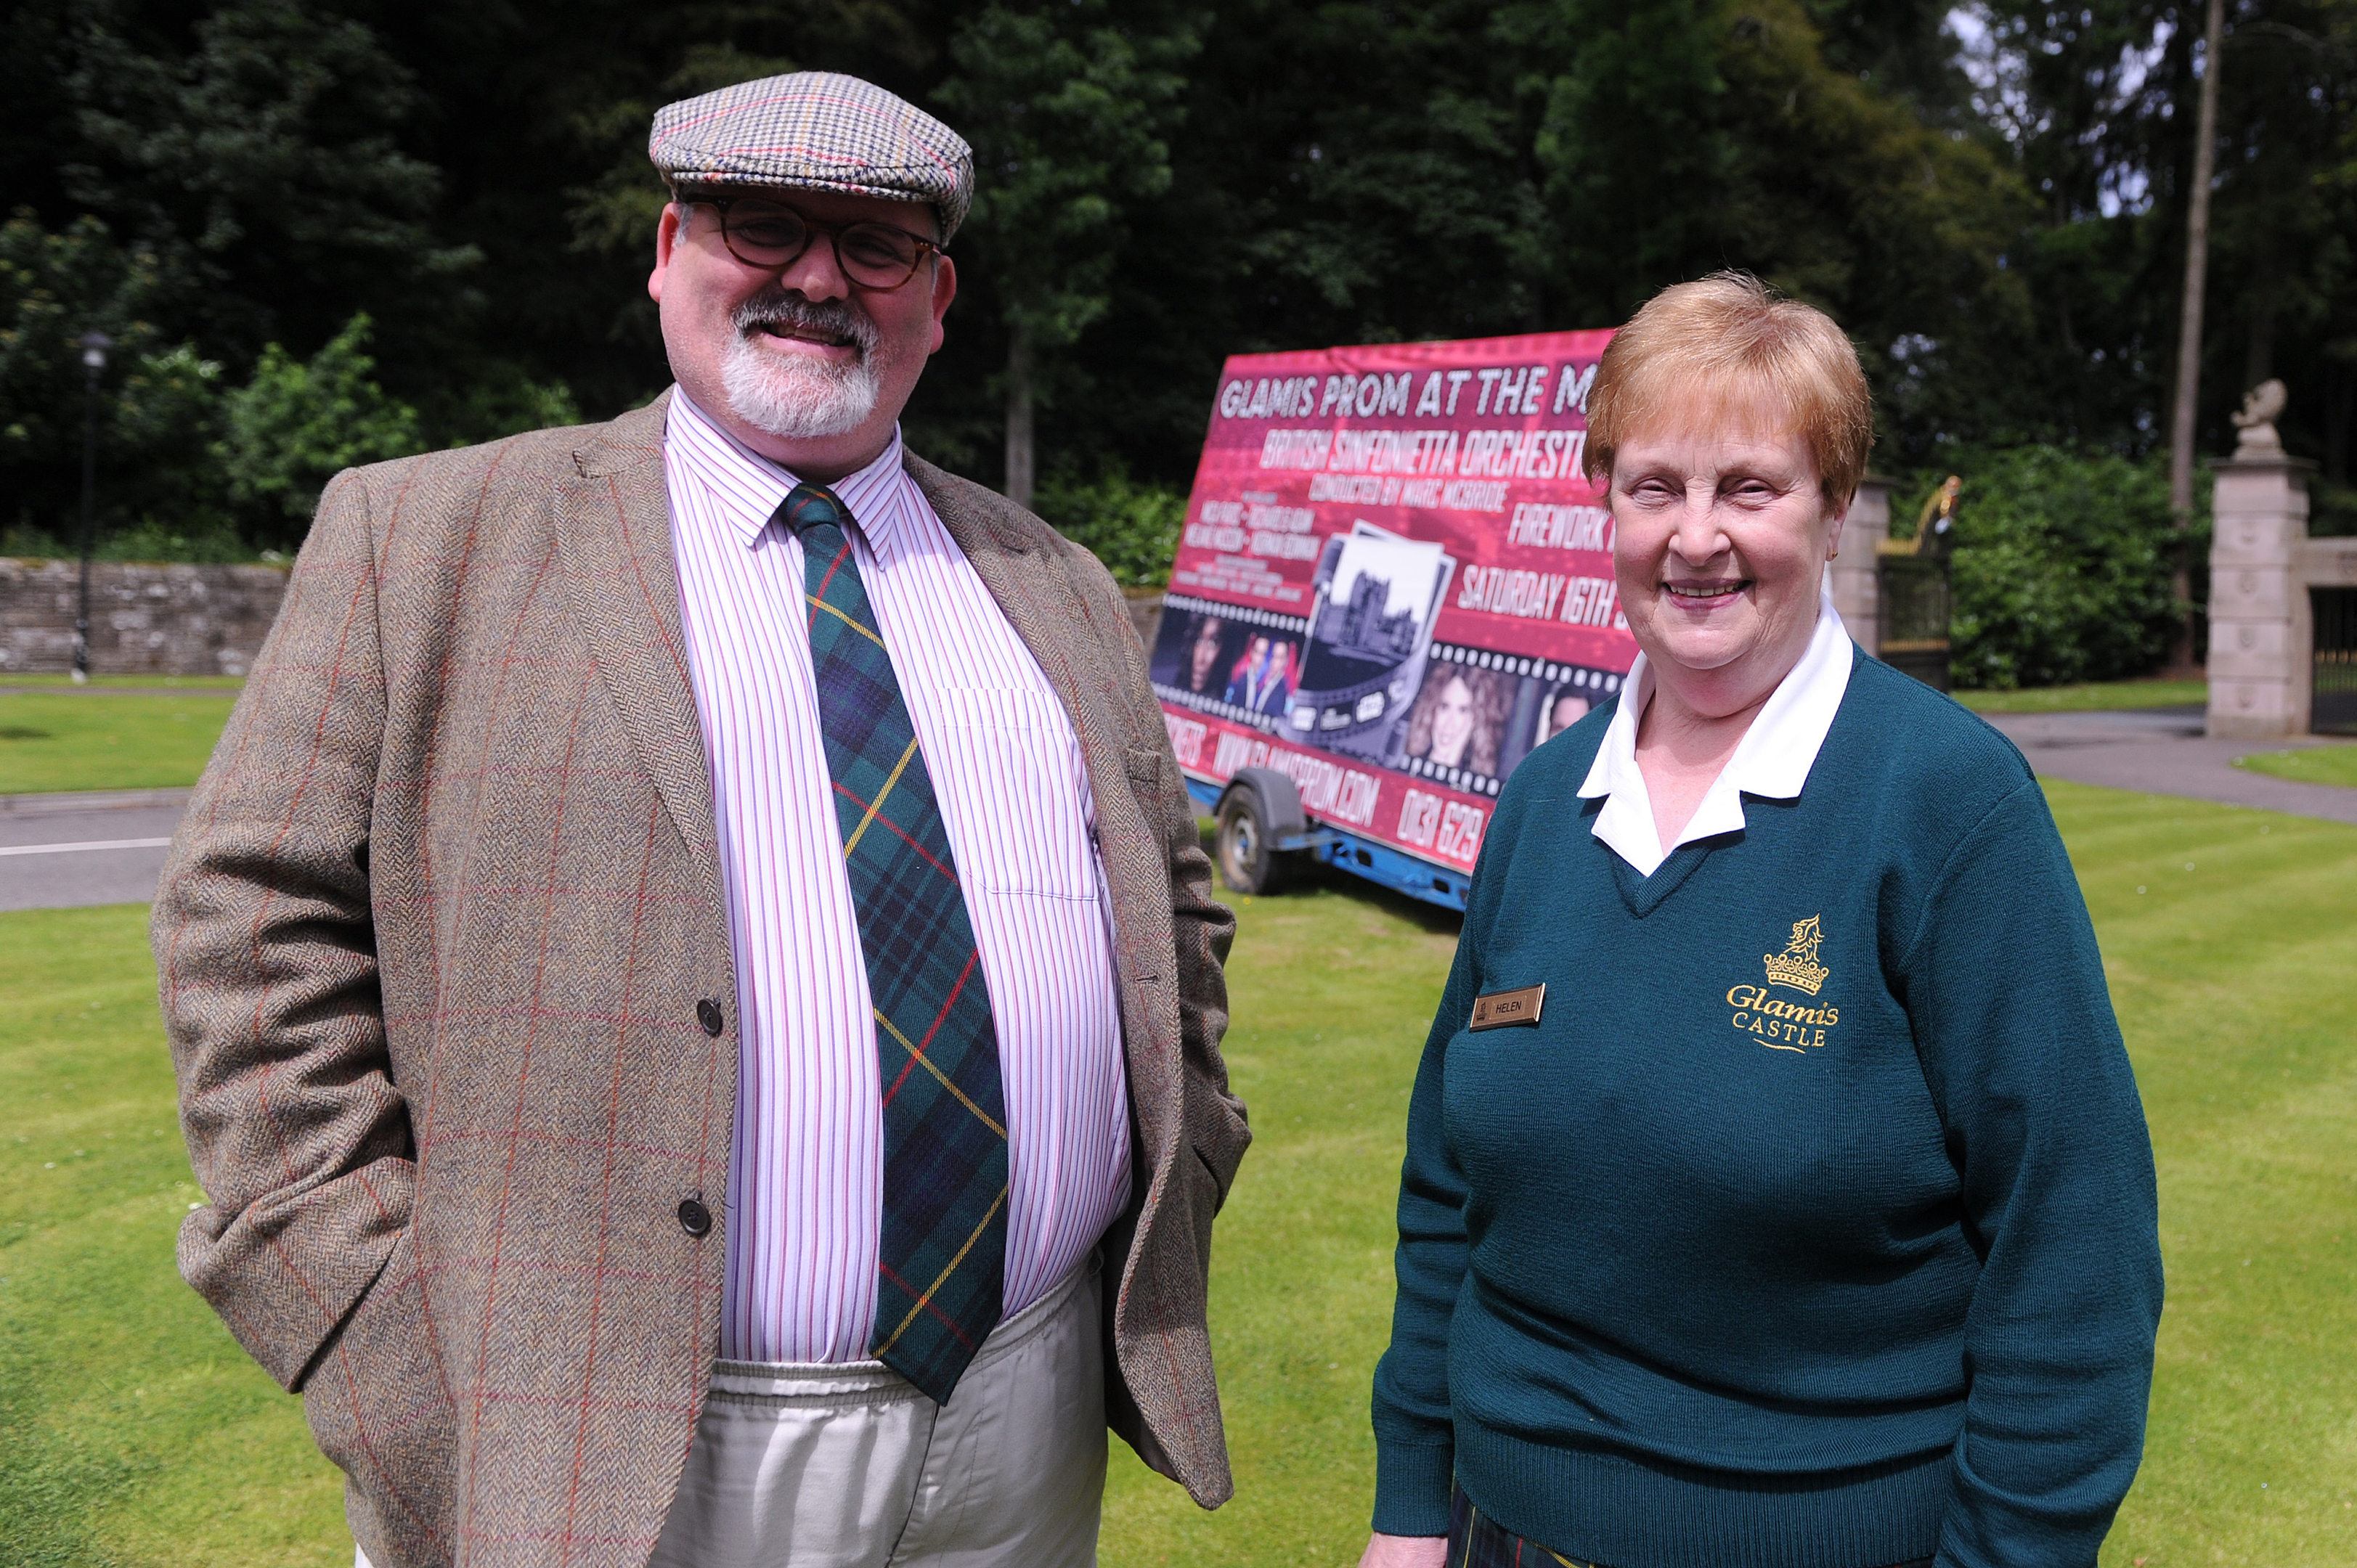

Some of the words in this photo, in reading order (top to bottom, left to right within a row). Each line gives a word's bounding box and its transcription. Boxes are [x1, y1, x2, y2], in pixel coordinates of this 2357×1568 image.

[1221, 377, 1317, 419] GLAMIS
[1319, 371, 1412, 417] PROM
[1415, 369, 1472, 418] AT
[1475, 365, 1549, 416] THE
[1552, 364, 1598, 415] M
[1259, 428, 1334, 470] BRITISH
[1329, 428, 1460, 475] SINFONIETTA
[1458, 429, 1587, 479] ORCHESTR
[1507, 502, 1611, 552] FIREWORK
[1457, 564, 1566, 621] SATURDAY
[1559, 576, 1617, 629] 16TH
[1436, 801, 1485, 863] 629
[1495, 1000, 1522, 1014] HELEN
[1725, 984, 1839, 1026] Glamis
[1732, 1012, 1826, 1048] CASTLE
